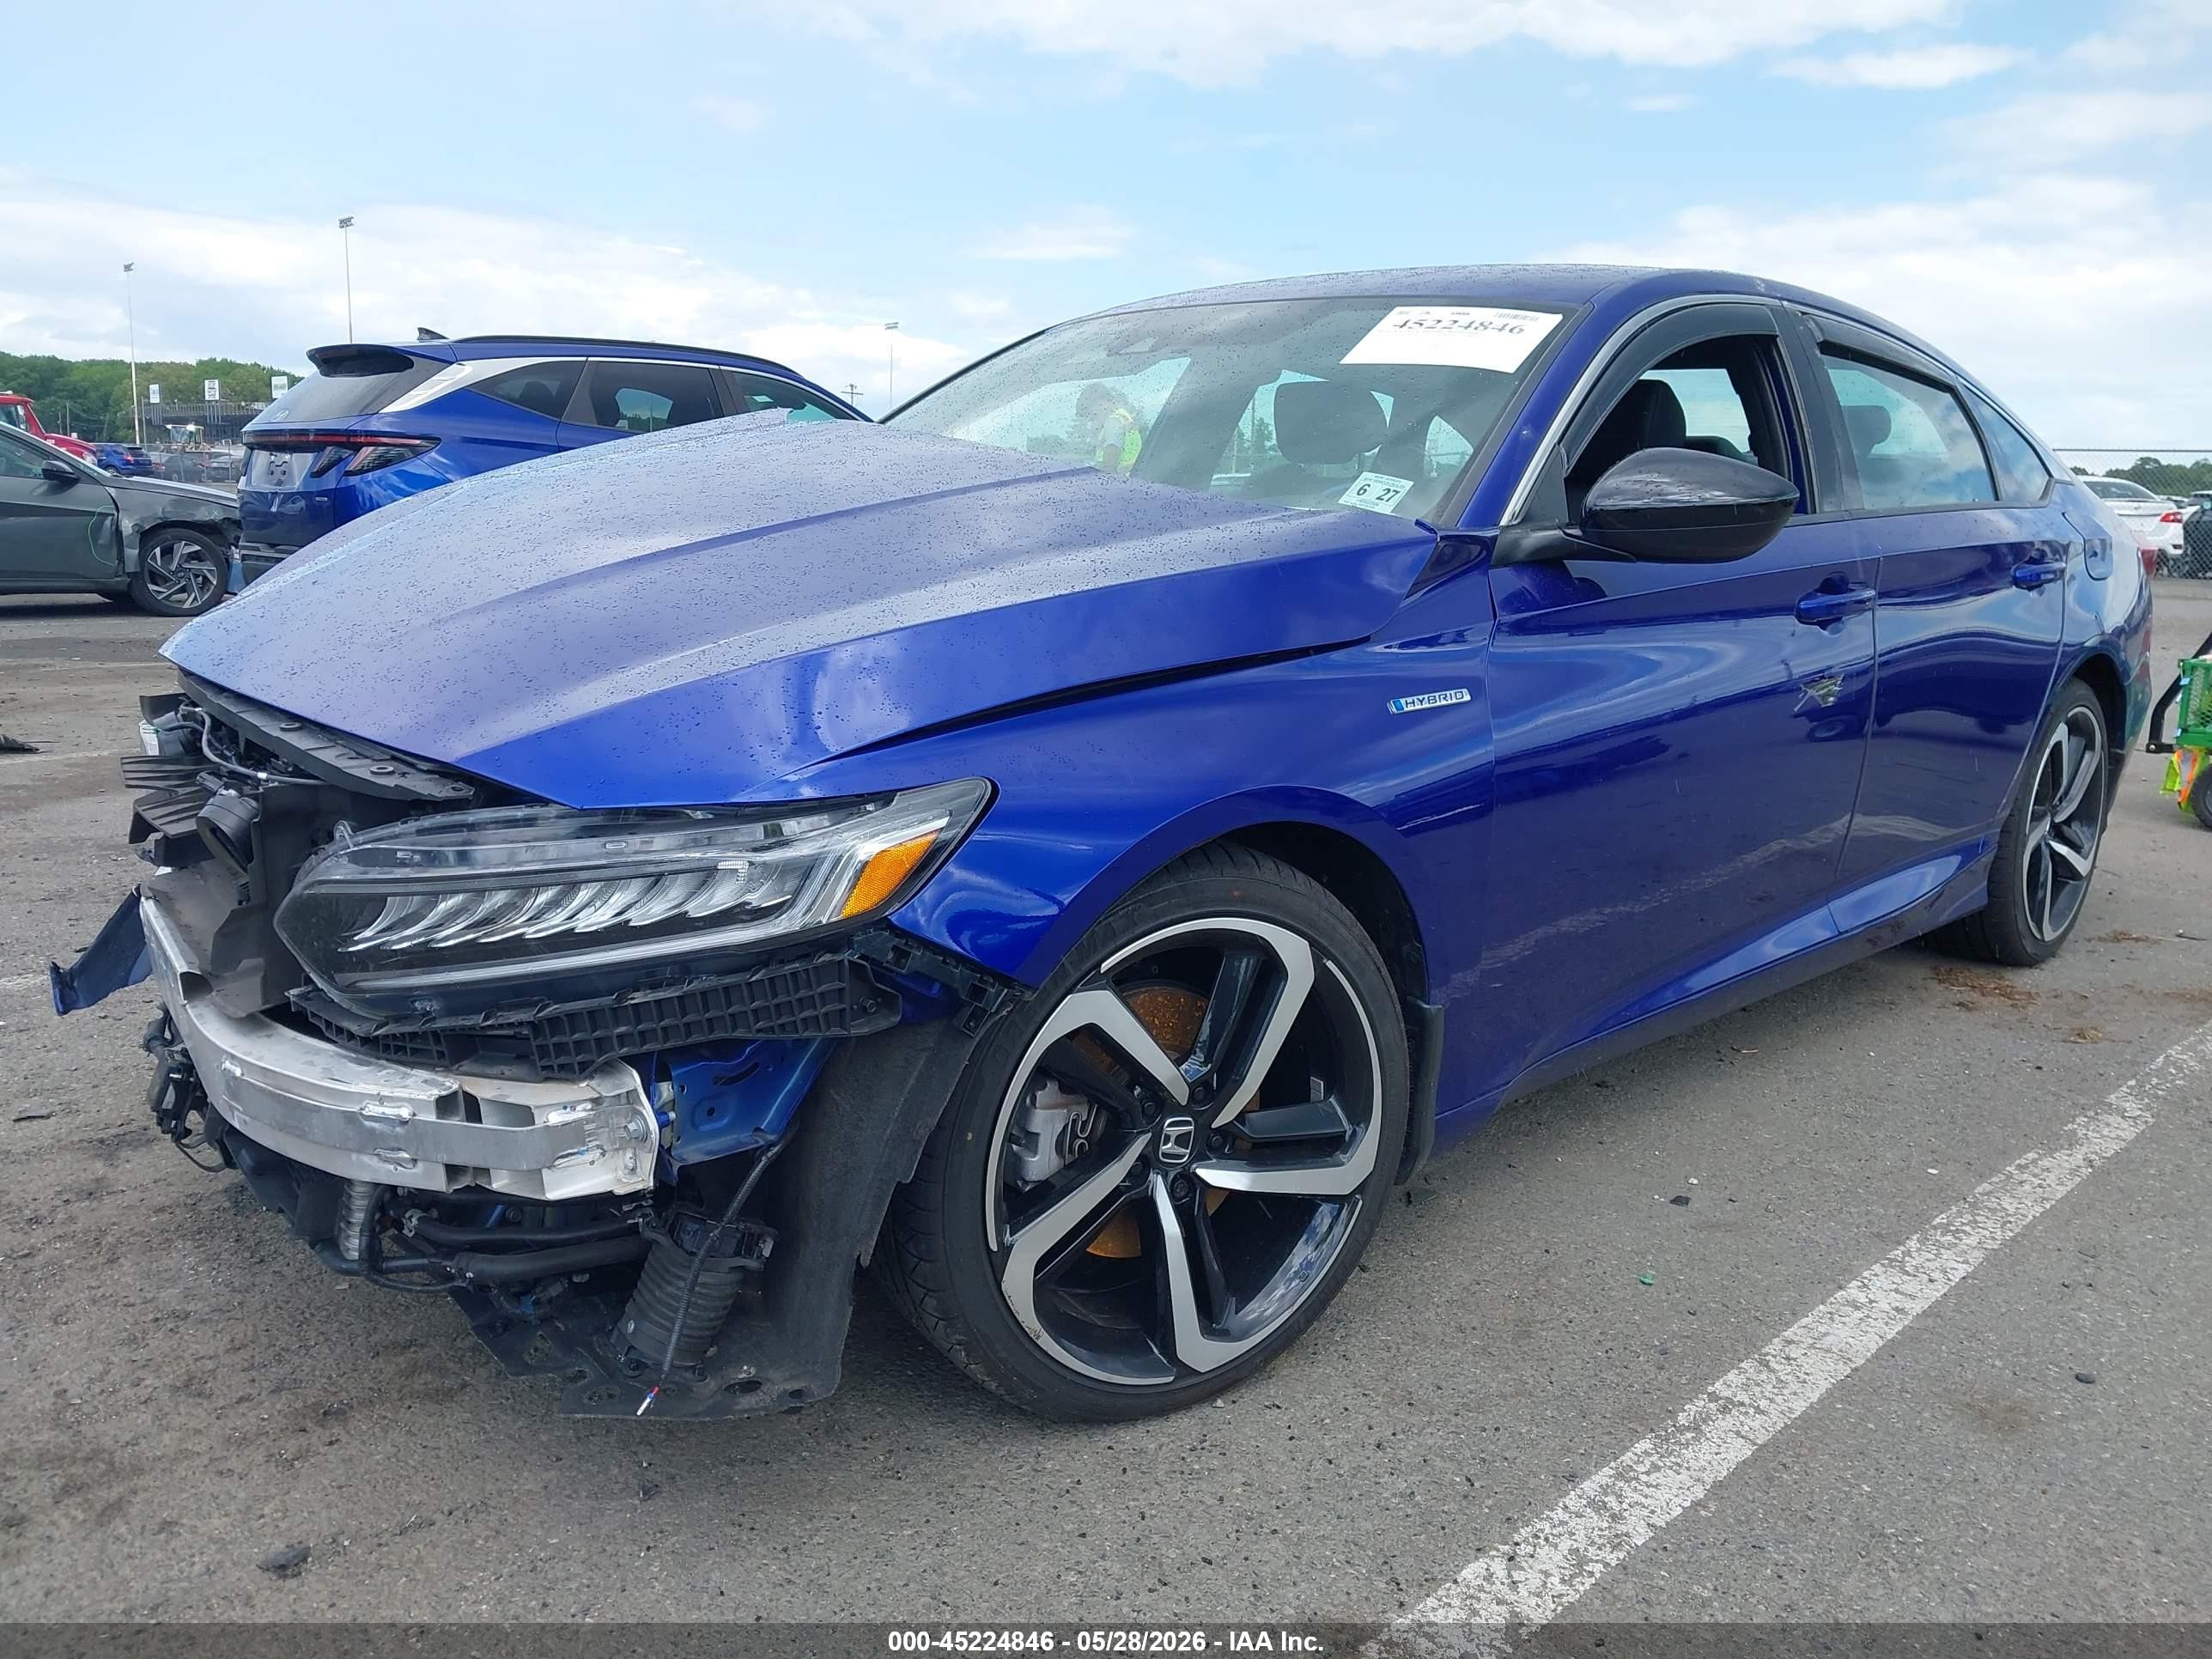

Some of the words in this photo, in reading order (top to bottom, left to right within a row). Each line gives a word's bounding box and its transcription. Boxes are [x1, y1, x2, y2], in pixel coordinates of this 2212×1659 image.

[1392, 319, 1525, 336] 45224846
[1356, 483, 1371, 496] 6
[1375, 488, 1401, 503] 27
[1405, 690, 1465, 709] HYBRID
